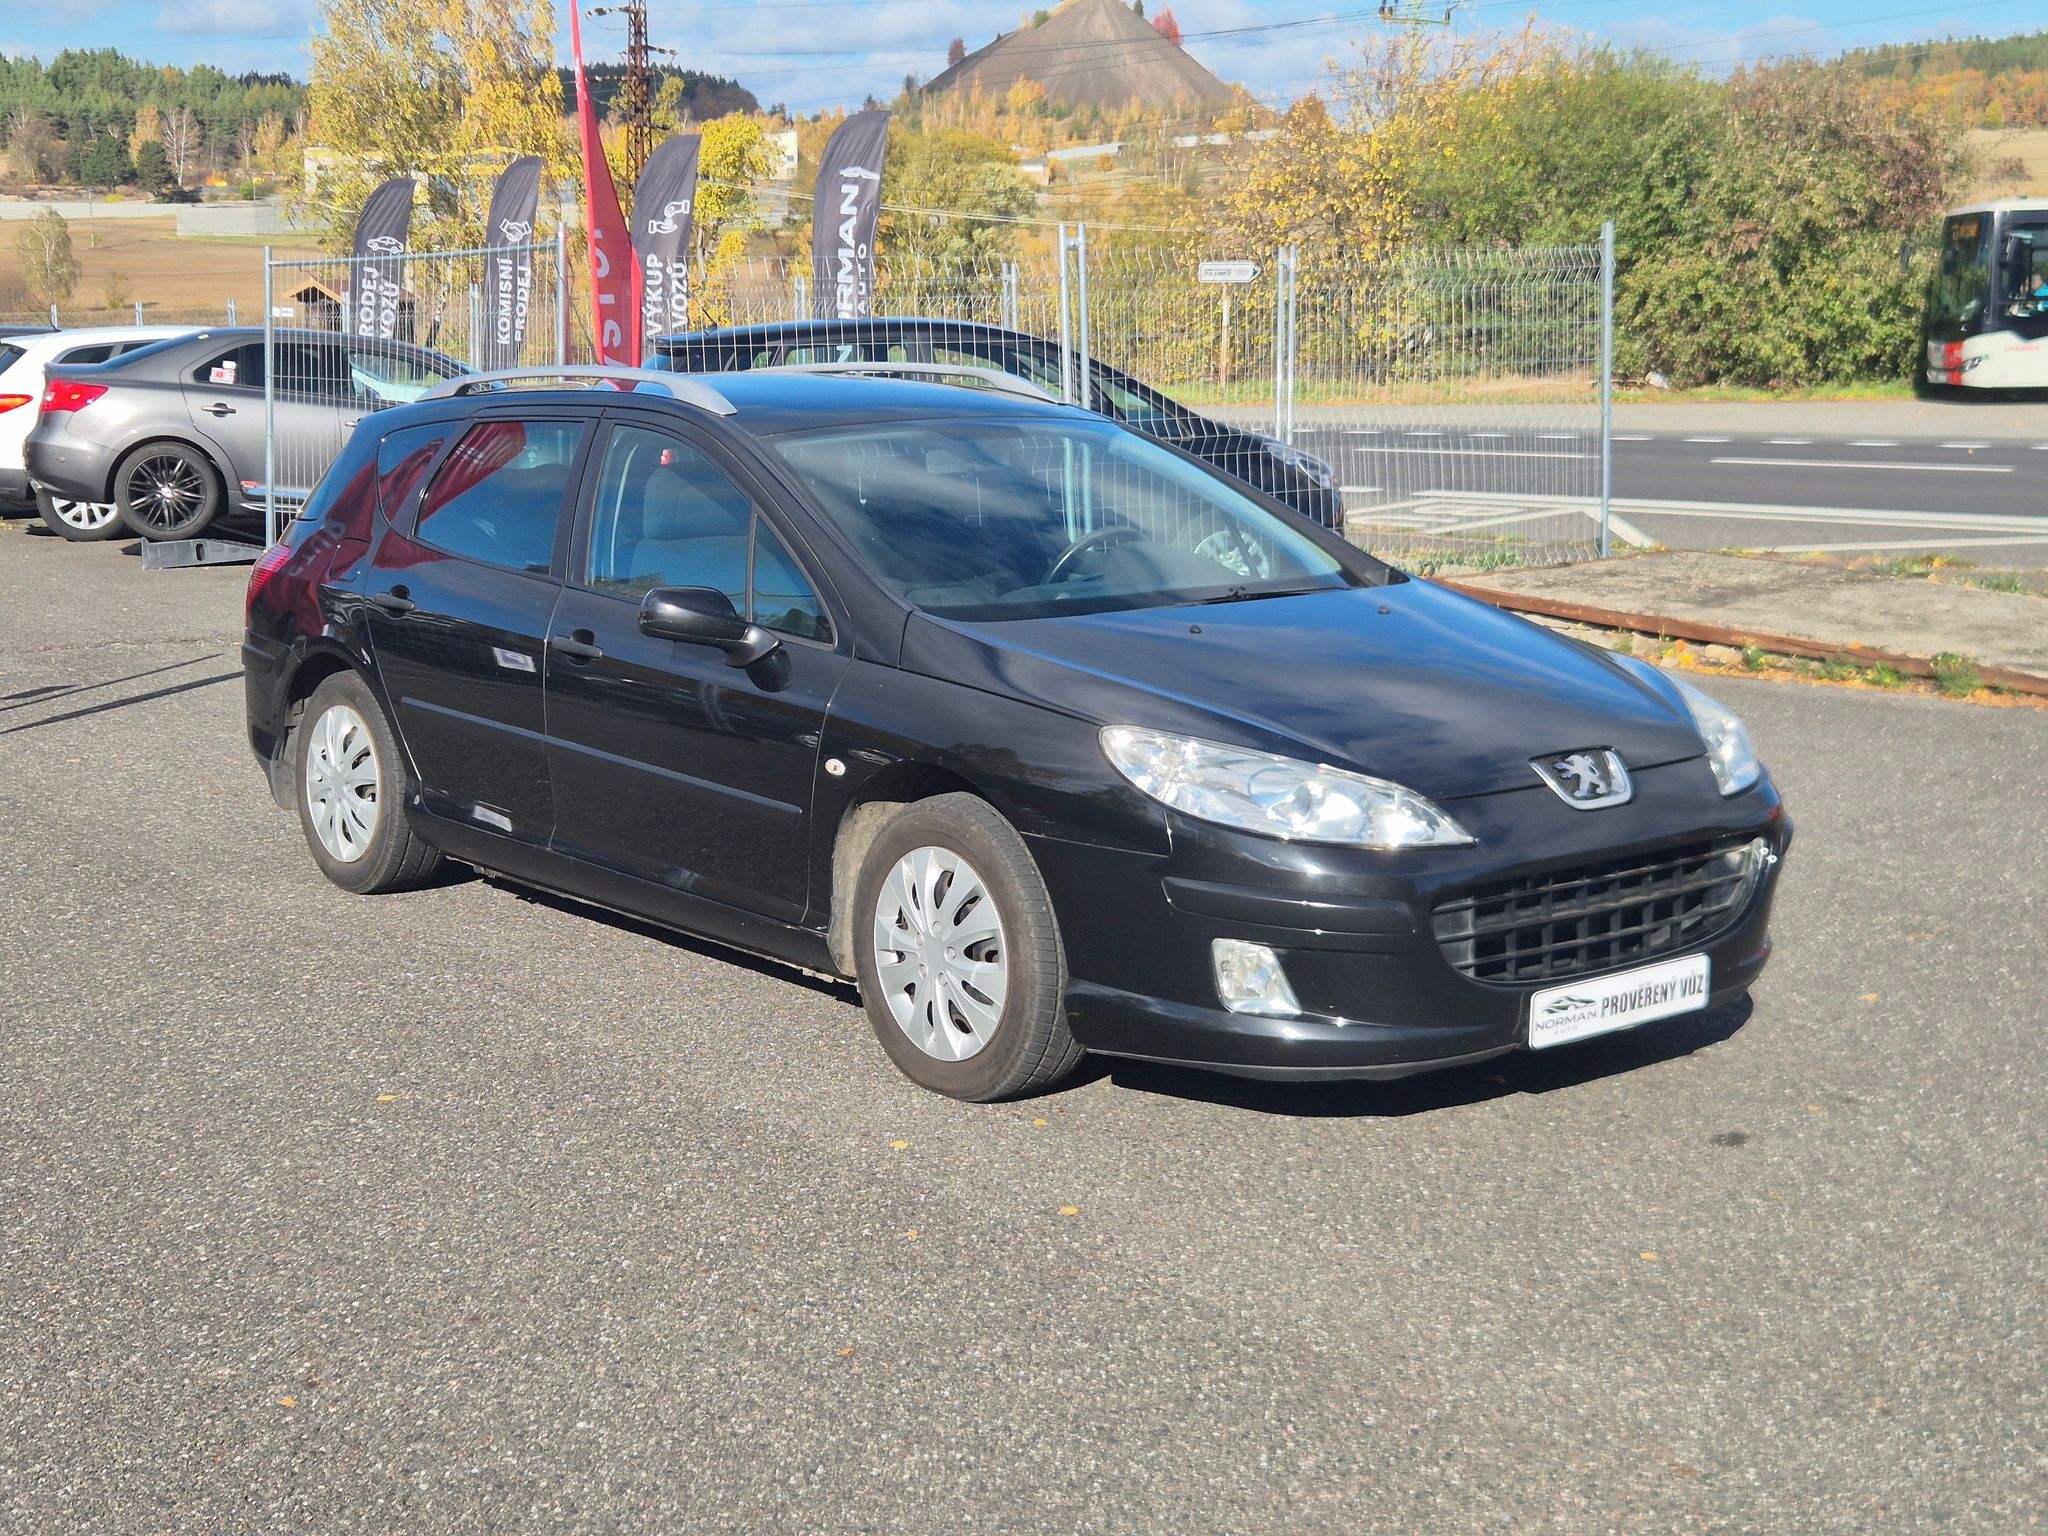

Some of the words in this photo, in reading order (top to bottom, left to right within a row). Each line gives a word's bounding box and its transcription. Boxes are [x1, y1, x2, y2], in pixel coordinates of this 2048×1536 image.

[836, 184, 859, 319] RMAN
[358, 266, 378, 337] RODEJ
[496, 257, 513, 345] KOMISNÍ
[514, 265, 532, 342] PRODEJ
[641, 253, 664, 338] VÝKUP
[666, 262, 688, 329] VOZŮ
[1535, 1010, 1597, 1032] NORMAN
[1600, 976, 1676, 1017] PROVĚŘENÝ
[1680, 970, 1703, 998] VŮZ
